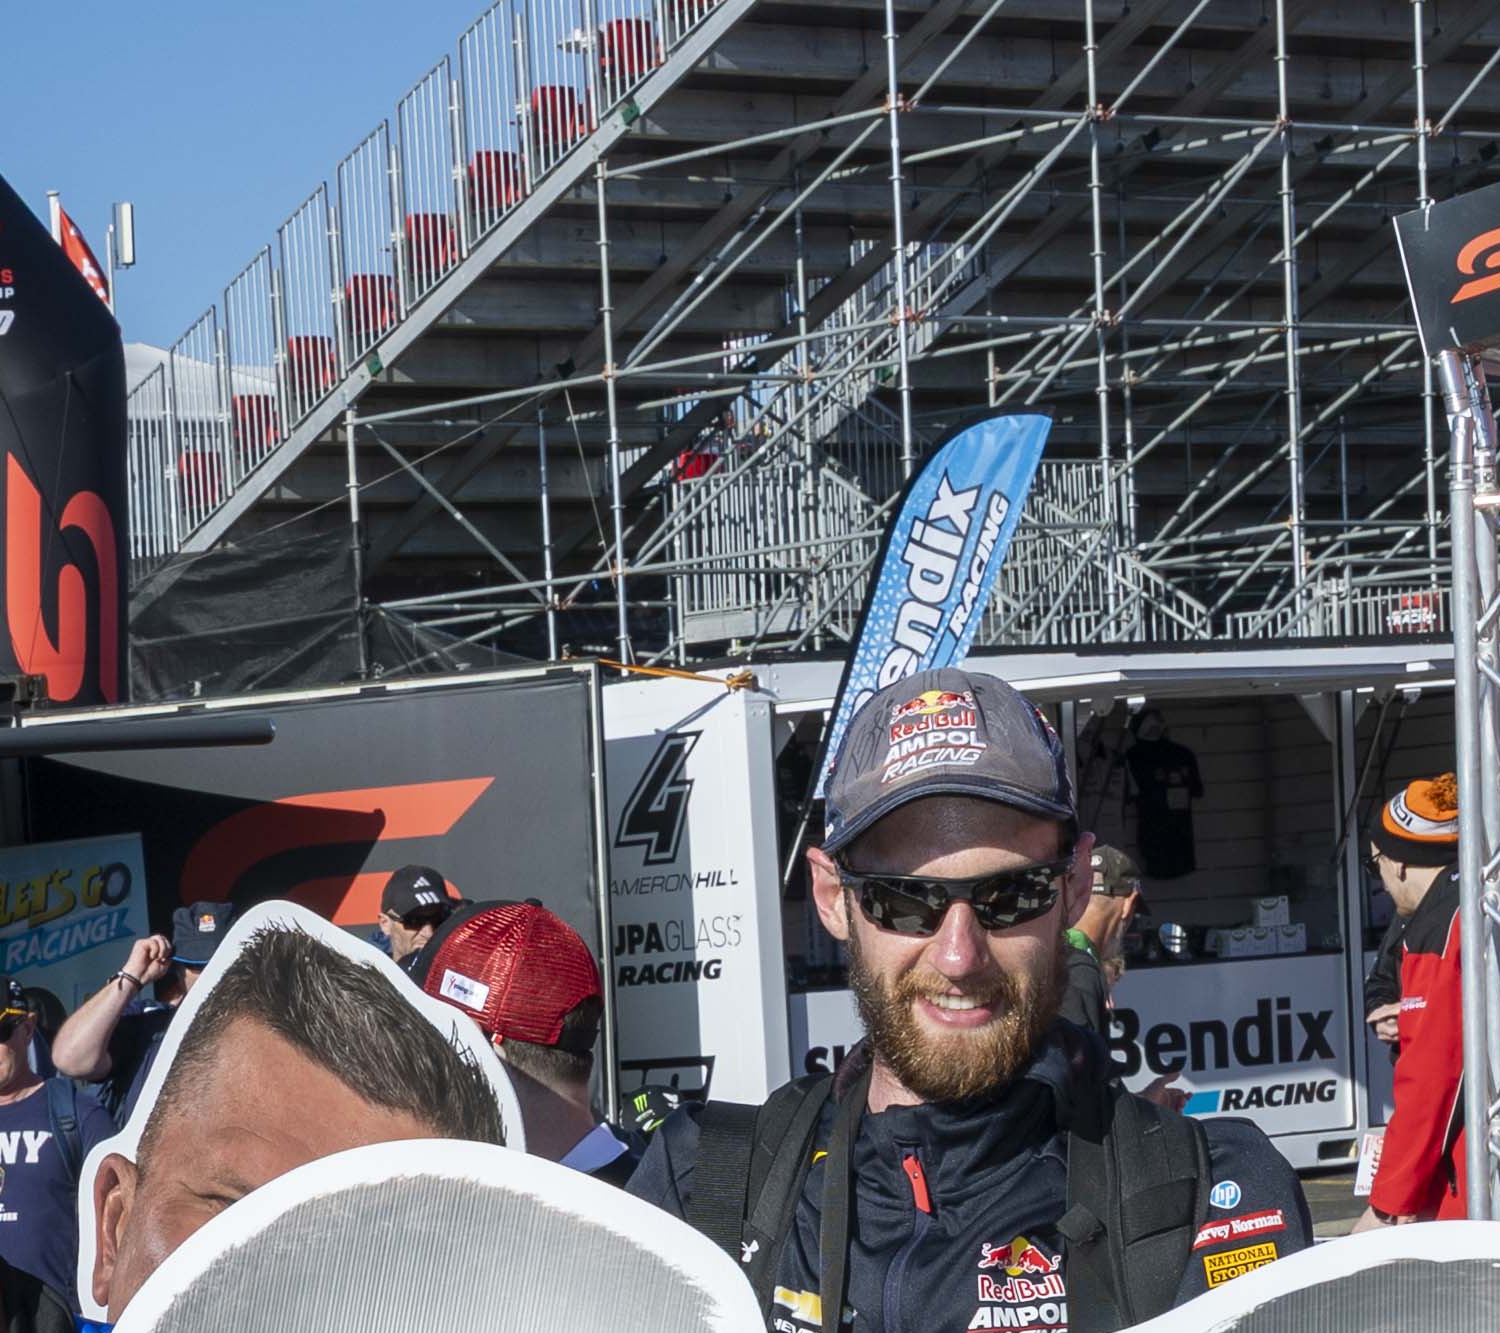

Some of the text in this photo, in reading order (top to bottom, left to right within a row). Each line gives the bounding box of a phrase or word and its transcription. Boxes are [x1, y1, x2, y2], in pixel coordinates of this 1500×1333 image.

[945, 489, 1010, 645] RACING
[889, 709, 977, 744] Red Bull
[882, 747, 981, 784] RACING
[884, 730, 986, 766] AMPOL
[614, 731, 703, 865] 4
[80, 861, 132, 912] GO
[611, 869, 738, 897] AMERONHILL
[5, 911, 118, 971] RACING!
[617, 958, 723, 987] RACING
[1104, 996, 1337, 1077] Bendix
[1221, 1080, 1338, 1111] RACING
[1214, 1183, 1239, 1207] hp
[1230, 1210, 1282, 1235] Norman
[1208, 1245, 1273, 1269] NATIONAL
[979, 1272, 1066, 1302] Red Bull
